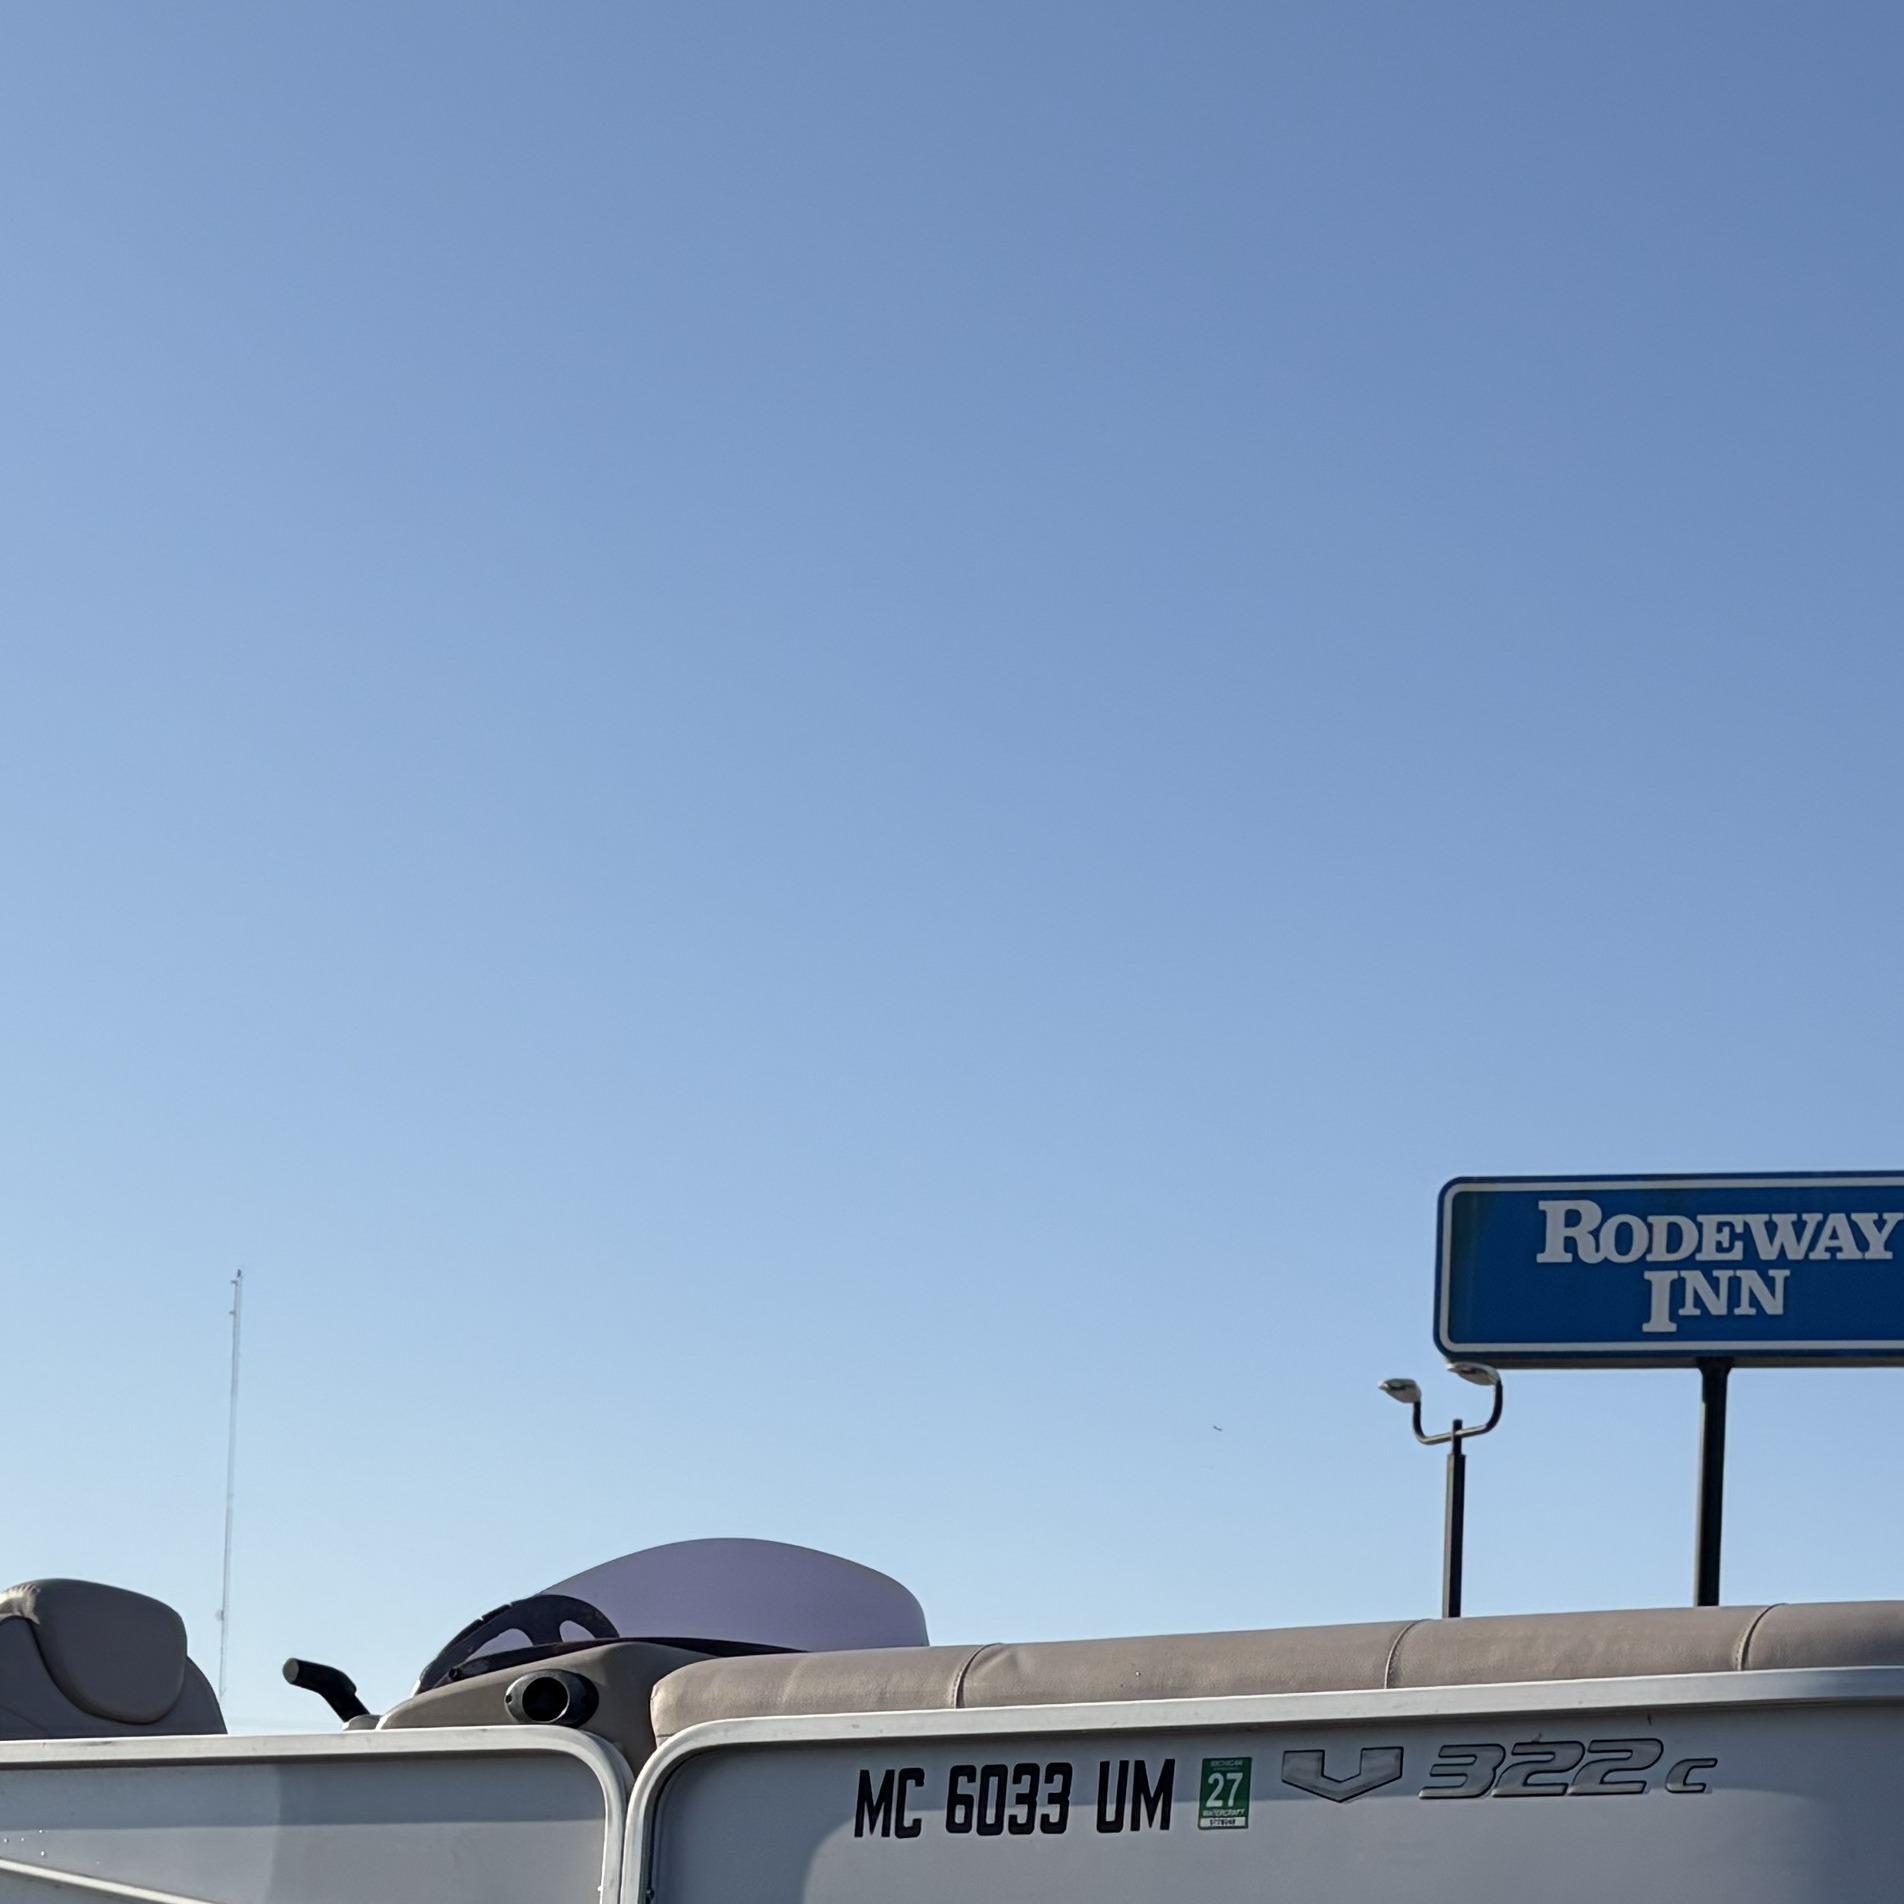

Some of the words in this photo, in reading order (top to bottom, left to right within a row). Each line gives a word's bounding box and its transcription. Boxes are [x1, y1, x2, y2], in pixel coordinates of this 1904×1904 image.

[1536, 1200, 1904, 1264] RODEWAY
[1642, 1269, 1790, 1333] INN
[854, 1767, 925, 1839] MC
[945, 1762, 1073, 1836] 6033
[1095, 1758, 1176, 1833] UM
[1205, 1772, 1244, 1808] 27
